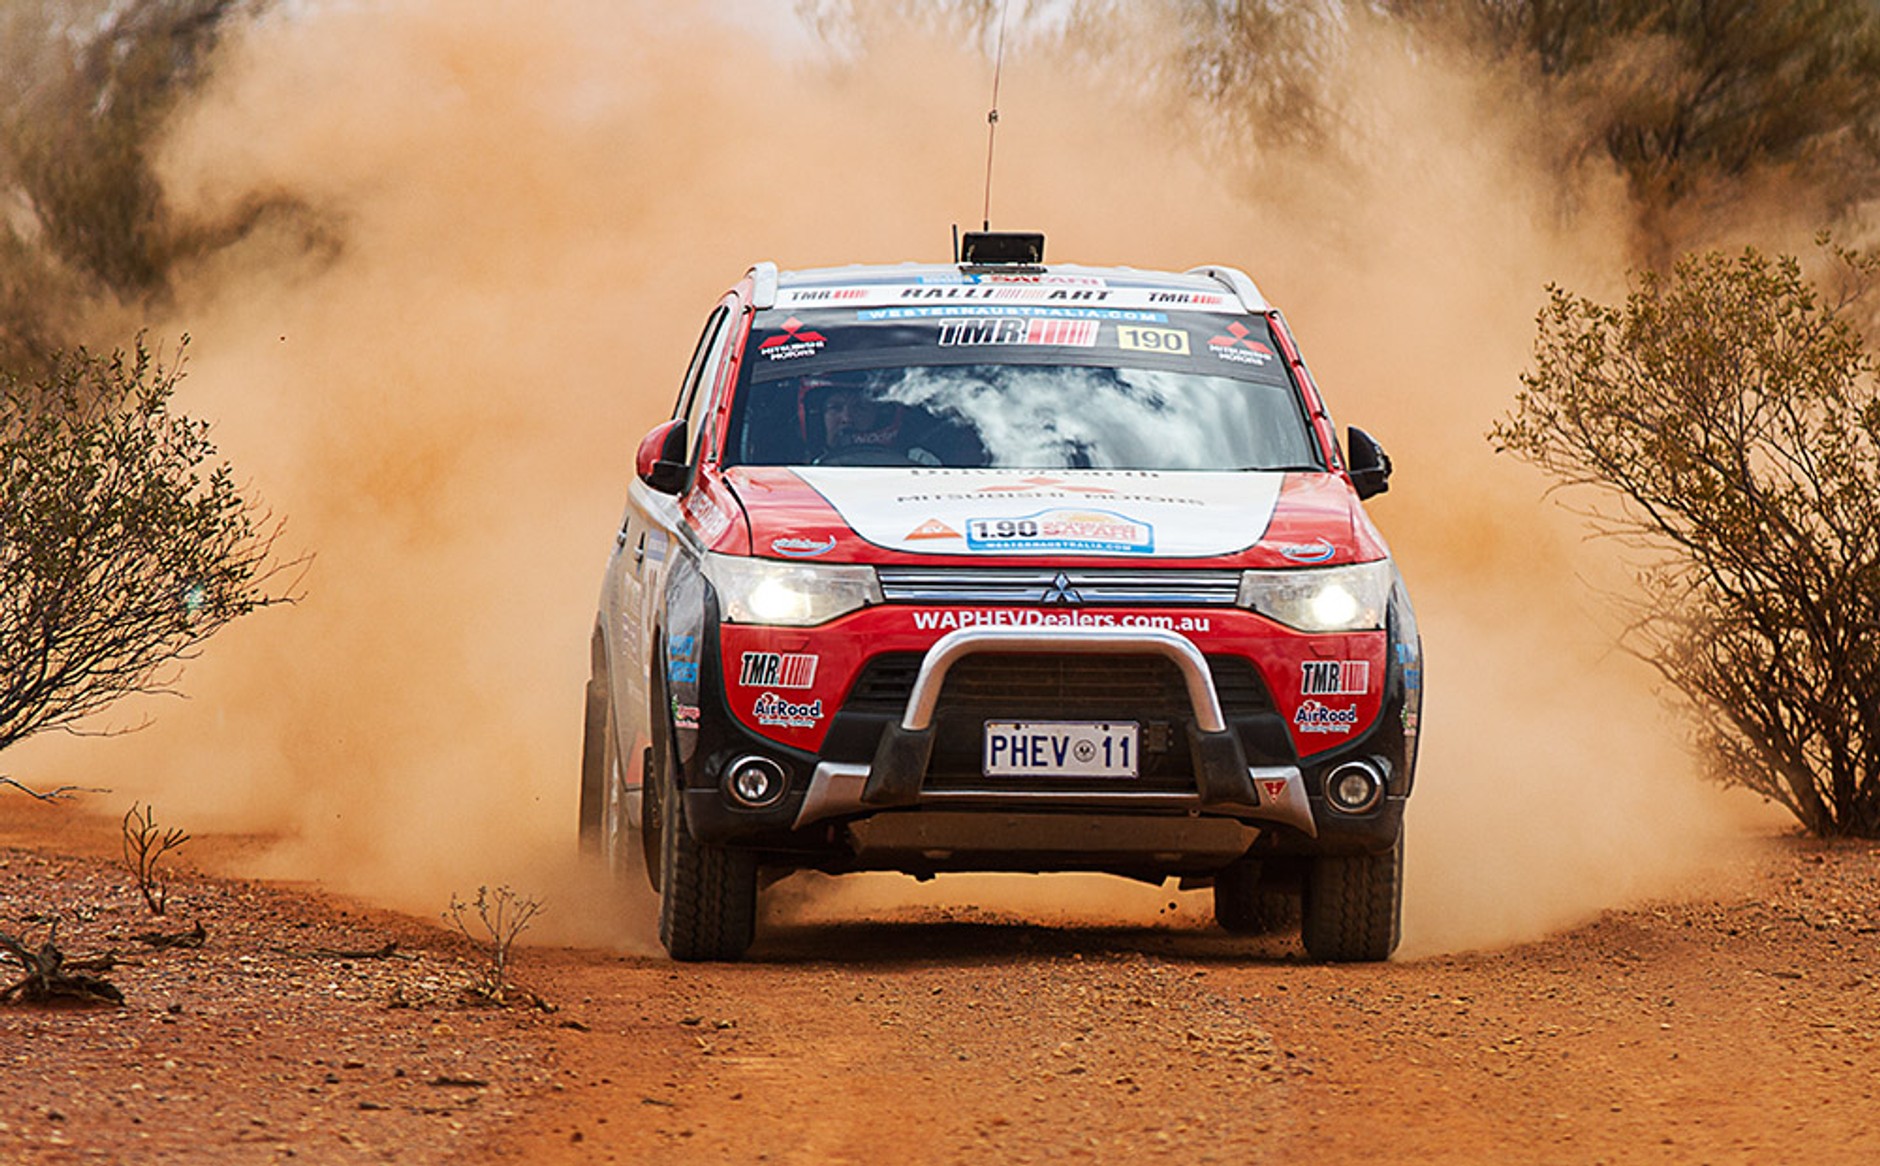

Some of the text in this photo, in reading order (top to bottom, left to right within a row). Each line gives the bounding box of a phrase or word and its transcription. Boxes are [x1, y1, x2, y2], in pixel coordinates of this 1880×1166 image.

[792, 290, 831, 301] TMR
[901, 288, 1114, 301] RALLI ART
[1149, 292, 1190, 303] TMR
[868, 308, 1157, 321] WESTERNAUSTRALIA.COM
[938, 317, 1024, 347] TMR
[1125, 329, 1183, 351] 190
[913, 610, 1210, 632] WAPHEVDealers.com.au
[740, 653, 780, 686] TMR
[1302, 661, 1340, 694] TMR
[754, 699, 822, 717] AirRoad
[1295, 704, 1357, 723] AirRoad
[990, 735, 1129, 768] PHEV 11
